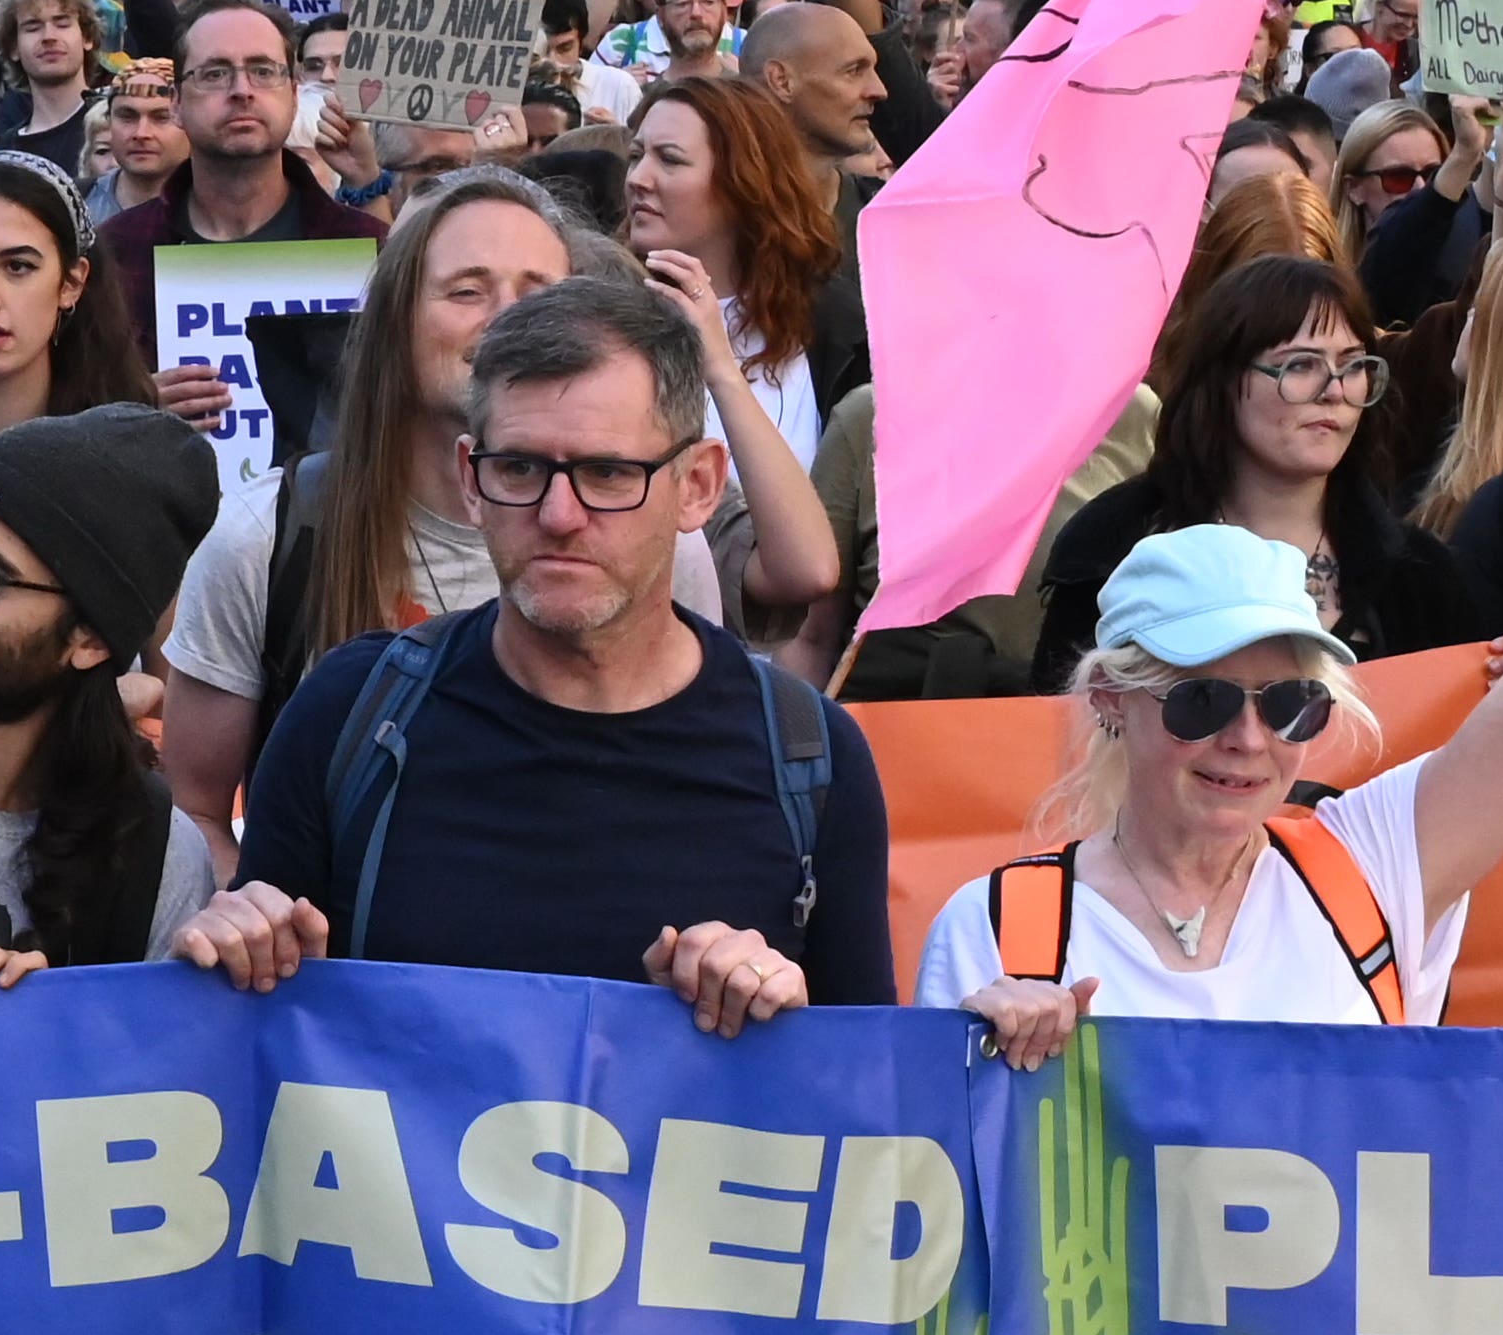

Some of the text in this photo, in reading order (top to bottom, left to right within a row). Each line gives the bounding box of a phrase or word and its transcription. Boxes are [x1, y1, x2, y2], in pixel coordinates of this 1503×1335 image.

[344, 30, 530, 89] ON YOUR PLATE
[1427, 56, 1451, 82] ALL
